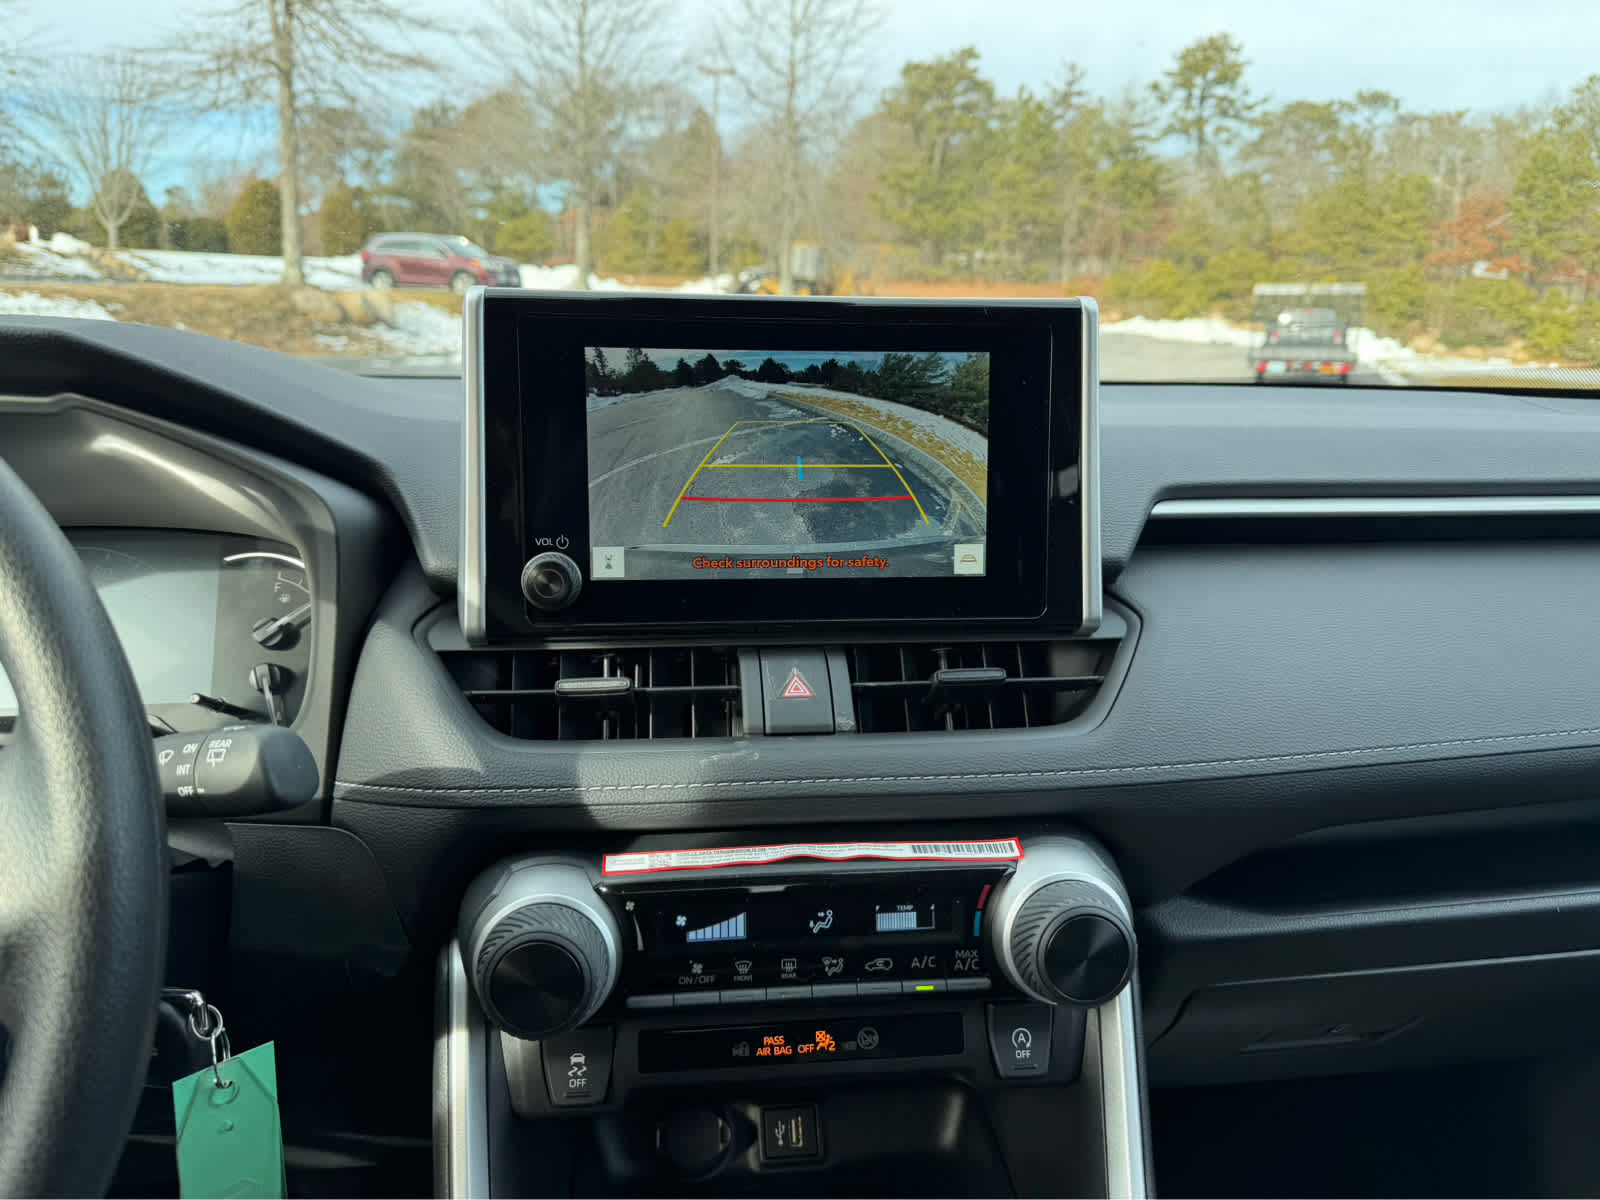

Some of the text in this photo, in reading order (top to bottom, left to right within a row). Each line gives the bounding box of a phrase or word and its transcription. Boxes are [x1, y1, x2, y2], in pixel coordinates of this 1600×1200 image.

[535, 537, 554, 546] VOL
[692, 555, 889, 570] Check surroundings for safety.
[182, 743, 199, 753] ON
[208, 739, 232, 748] REAR
[176, 764, 192, 776] INT
[177, 785, 193, 797] OFF
[954, 950, 979, 958] MAX
[911, 956, 936, 969] A/C
[954, 959, 980, 971] A/C
[678, 975, 715, 985] ON/OFF
[763, 1036, 785, 1046] PASS
[756, 1044, 815, 1056] AIR BAG OFF
[1015, 1050, 1031, 1059] OFF
[569, 1079, 588, 1088] OFF
